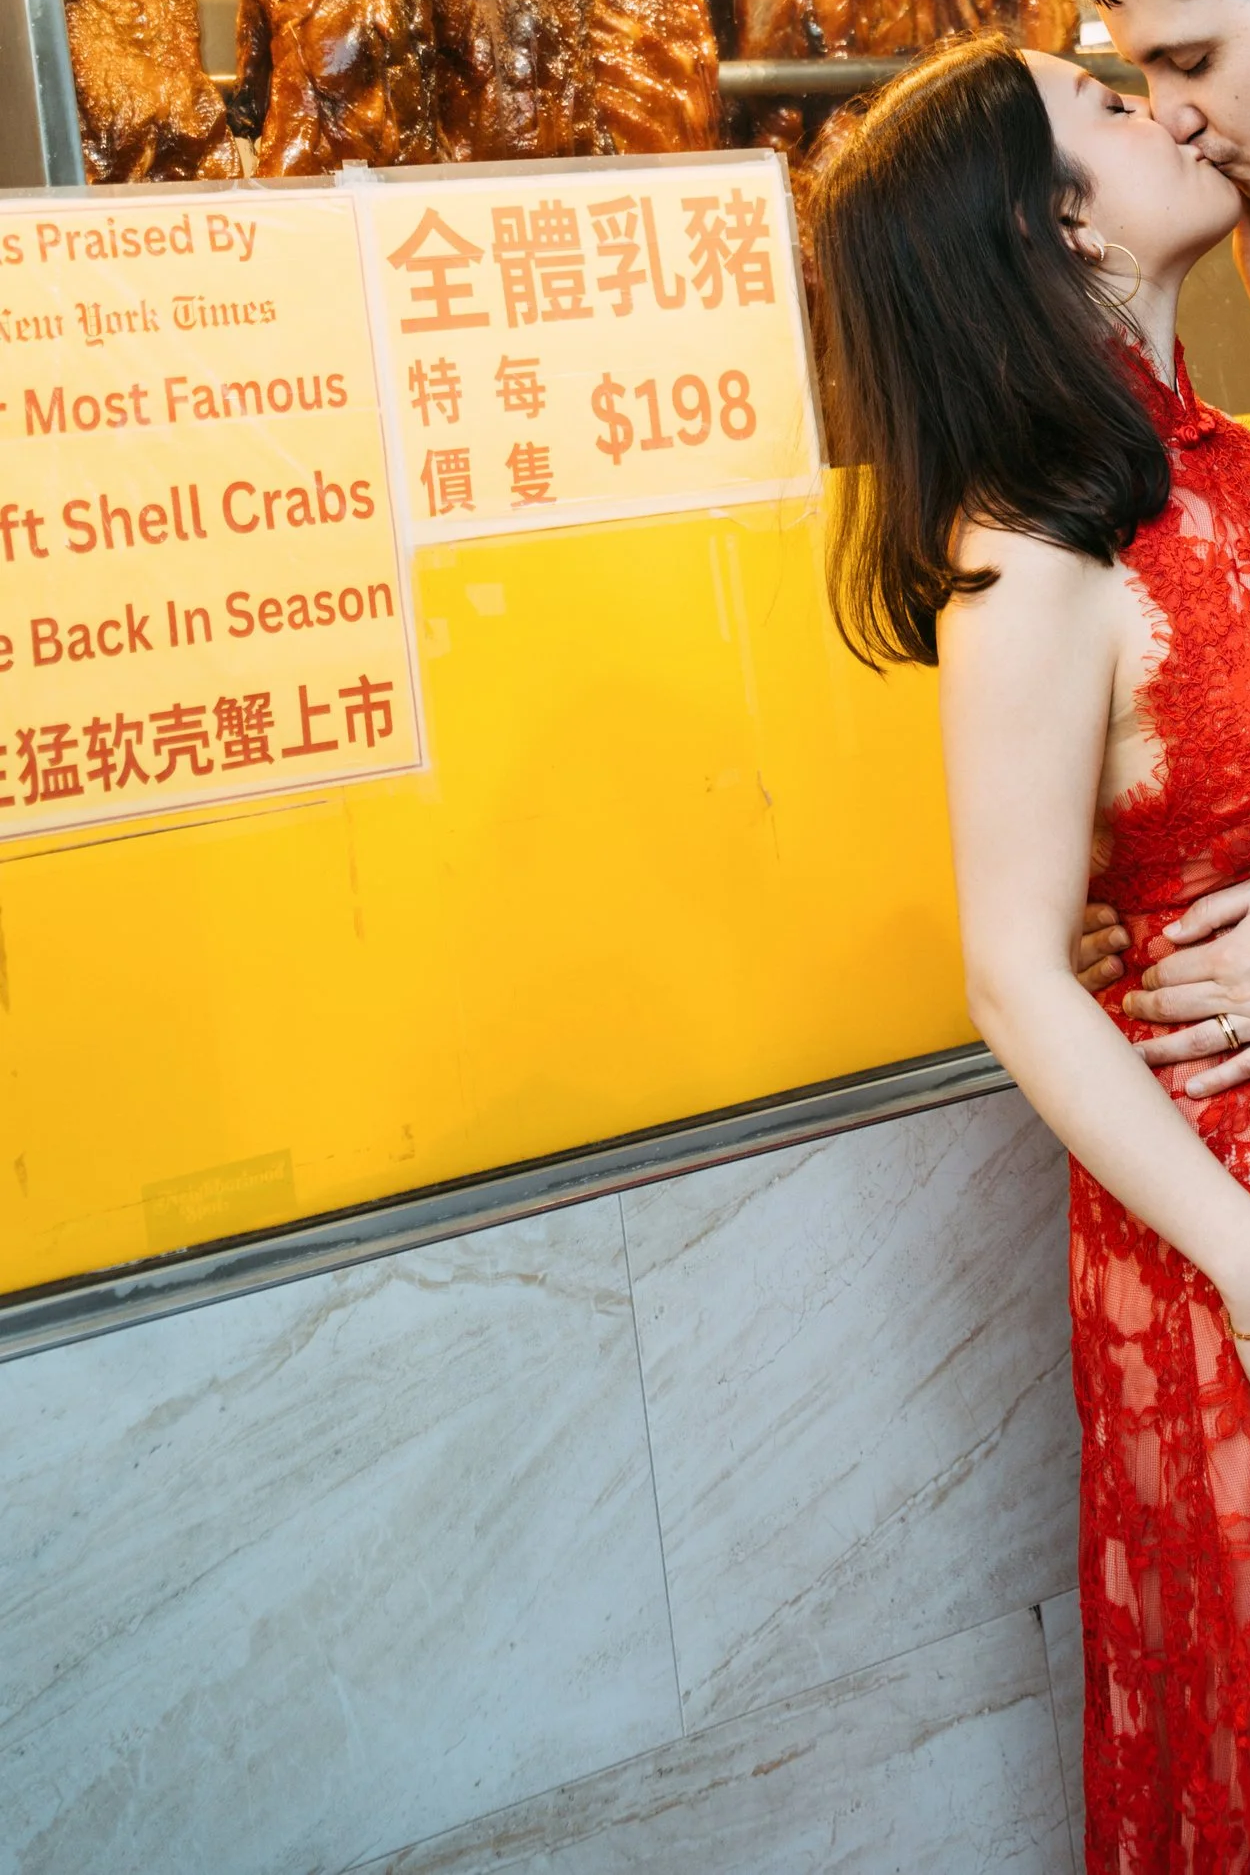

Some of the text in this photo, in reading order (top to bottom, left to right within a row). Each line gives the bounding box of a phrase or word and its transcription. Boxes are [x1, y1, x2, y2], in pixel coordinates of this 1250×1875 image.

[0, 212, 258, 266] s Praised By
[386, 187, 776, 334] 全體乳豬
[75, 299, 161, 348] York
[171, 294, 278, 332] Times
[24, 372, 349, 437] Most Famous
[590, 369, 758, 467] $198
[62, 483, 208, 554] Shell
[222, 469, 376, 534] Crabs
[29, 602, 155, 668] Back
[166, 599, 214, 648] In
[224, 580, 395, 639] Season
